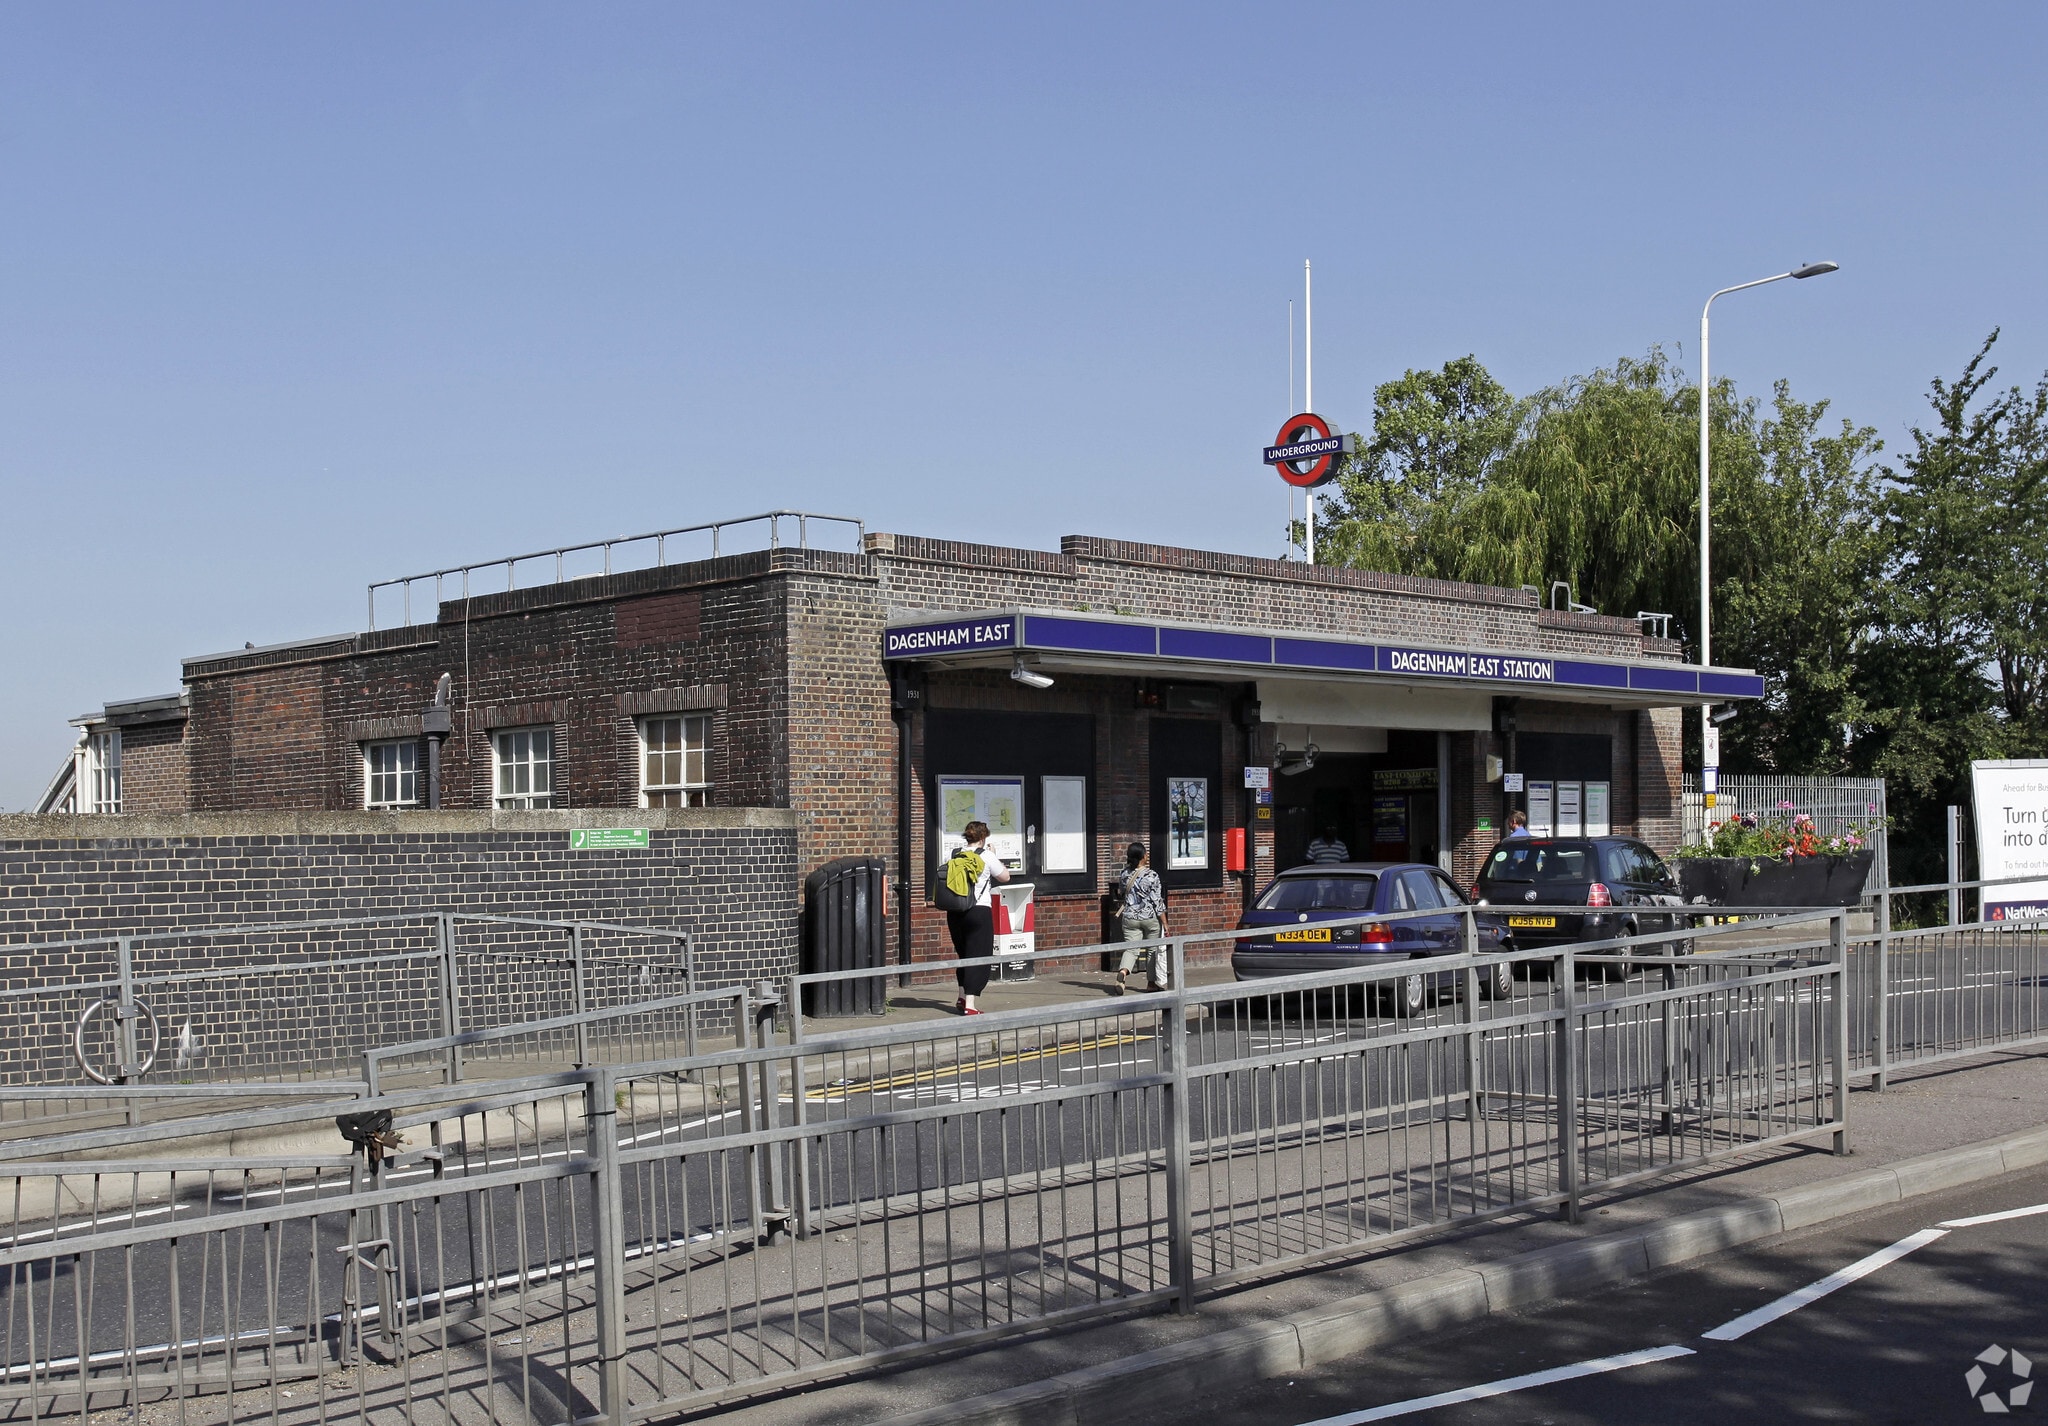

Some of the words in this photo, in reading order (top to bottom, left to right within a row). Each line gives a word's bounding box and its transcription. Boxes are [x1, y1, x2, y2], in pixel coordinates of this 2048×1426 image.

[1268, 439, 1339, 459] UNDERGROUND
[889, 627, 969, 651] DAGENHAM
[974, 623, 1011, 643] EAST
[1391, 651, 1466, 674] DAGENHAM
[1470, 657, 1500, 676] EAST
[1503, 659, 1551, 680] STATION
[1395, 770, 1431, 779] LONDON
[2002, 783, 2025, 793] Ahead
[2026, 783, 2037, 792] for
[2002, 806, 2037, 824] Turn
[2003, 829, 2033, 847] into
[2004, 860, 2014, 869] To
[2015, 859, 2028, 869] find
[2029, 860, 2041, 869] out
[2004, 905, 2048, 920] NatWes
[1512, 916, 1534, 926] KJ56
[1535, 917, 1552, 926] NVB
[1280, 930, 1305, 940] N334
[1307, 929, 1327, 940] OEW
[1009, 942, 1027, 950] news
